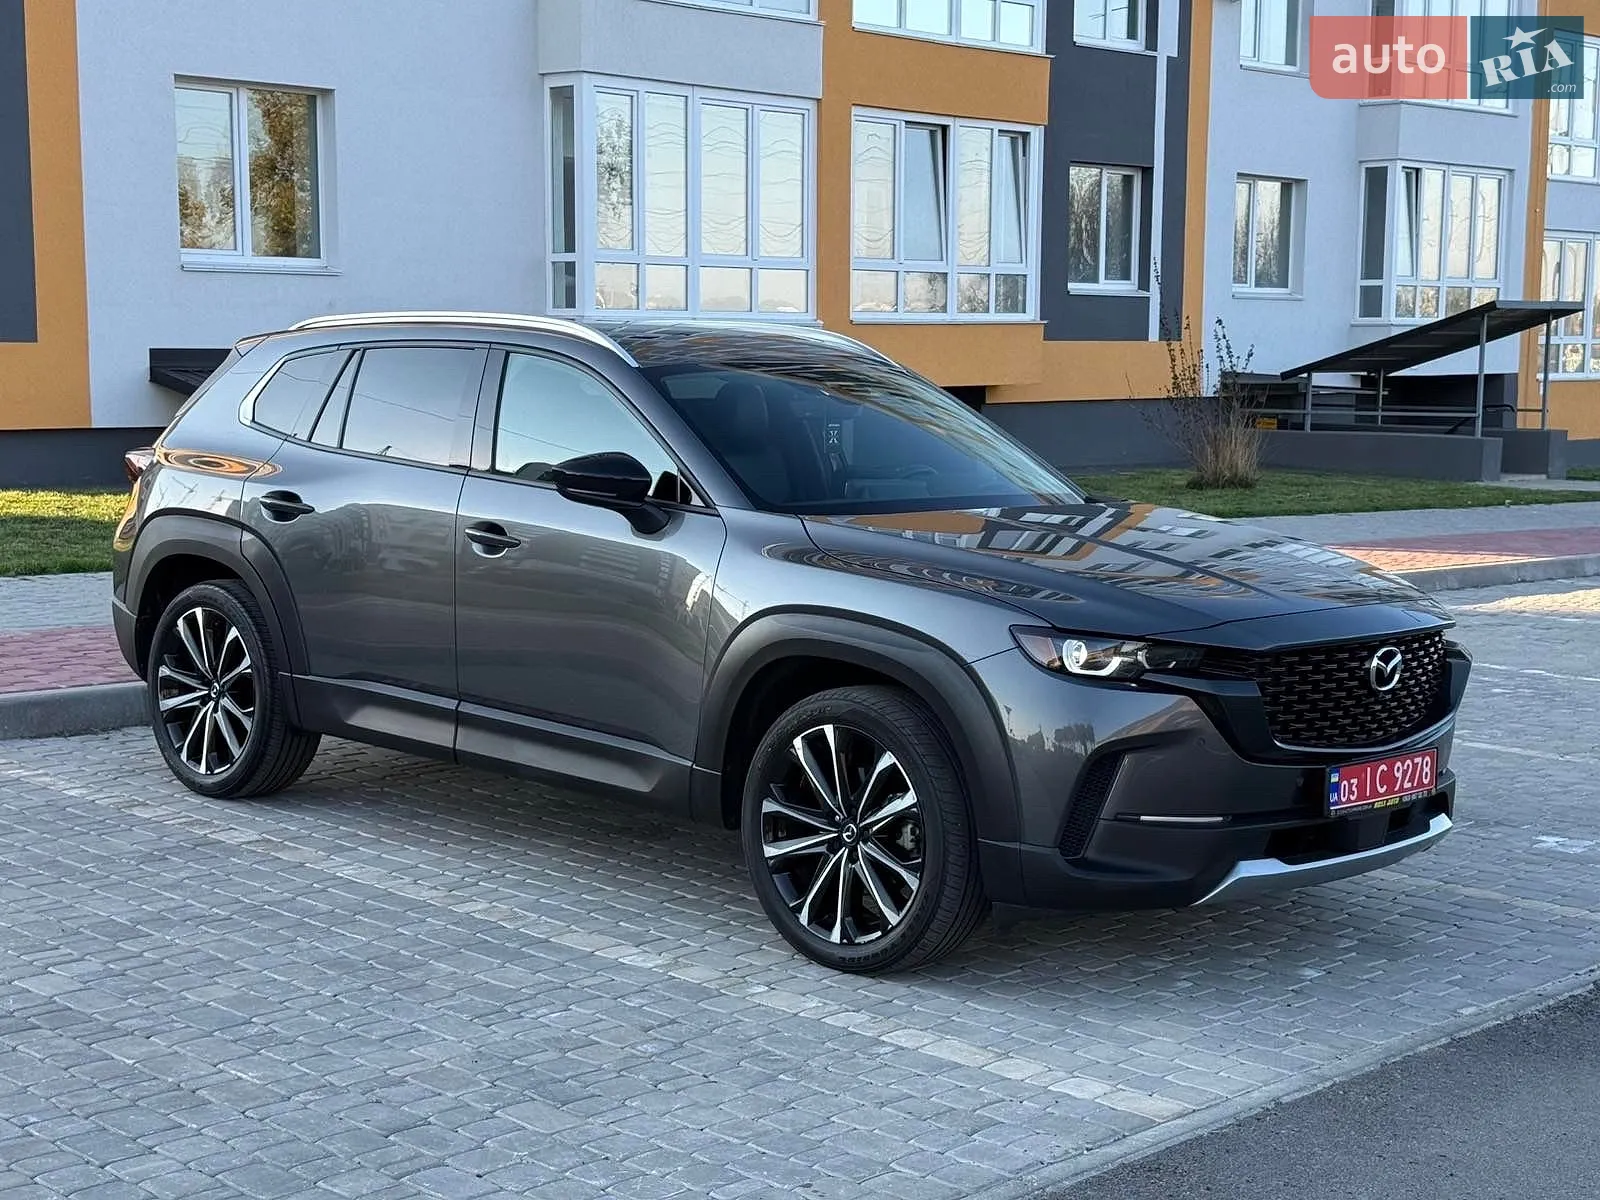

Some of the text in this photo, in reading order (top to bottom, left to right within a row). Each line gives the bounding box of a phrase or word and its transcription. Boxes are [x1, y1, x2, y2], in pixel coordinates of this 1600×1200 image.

[1340, 755, 1432, 802] 03 IC 9278
[1329, 793, 1339, 803] UA
